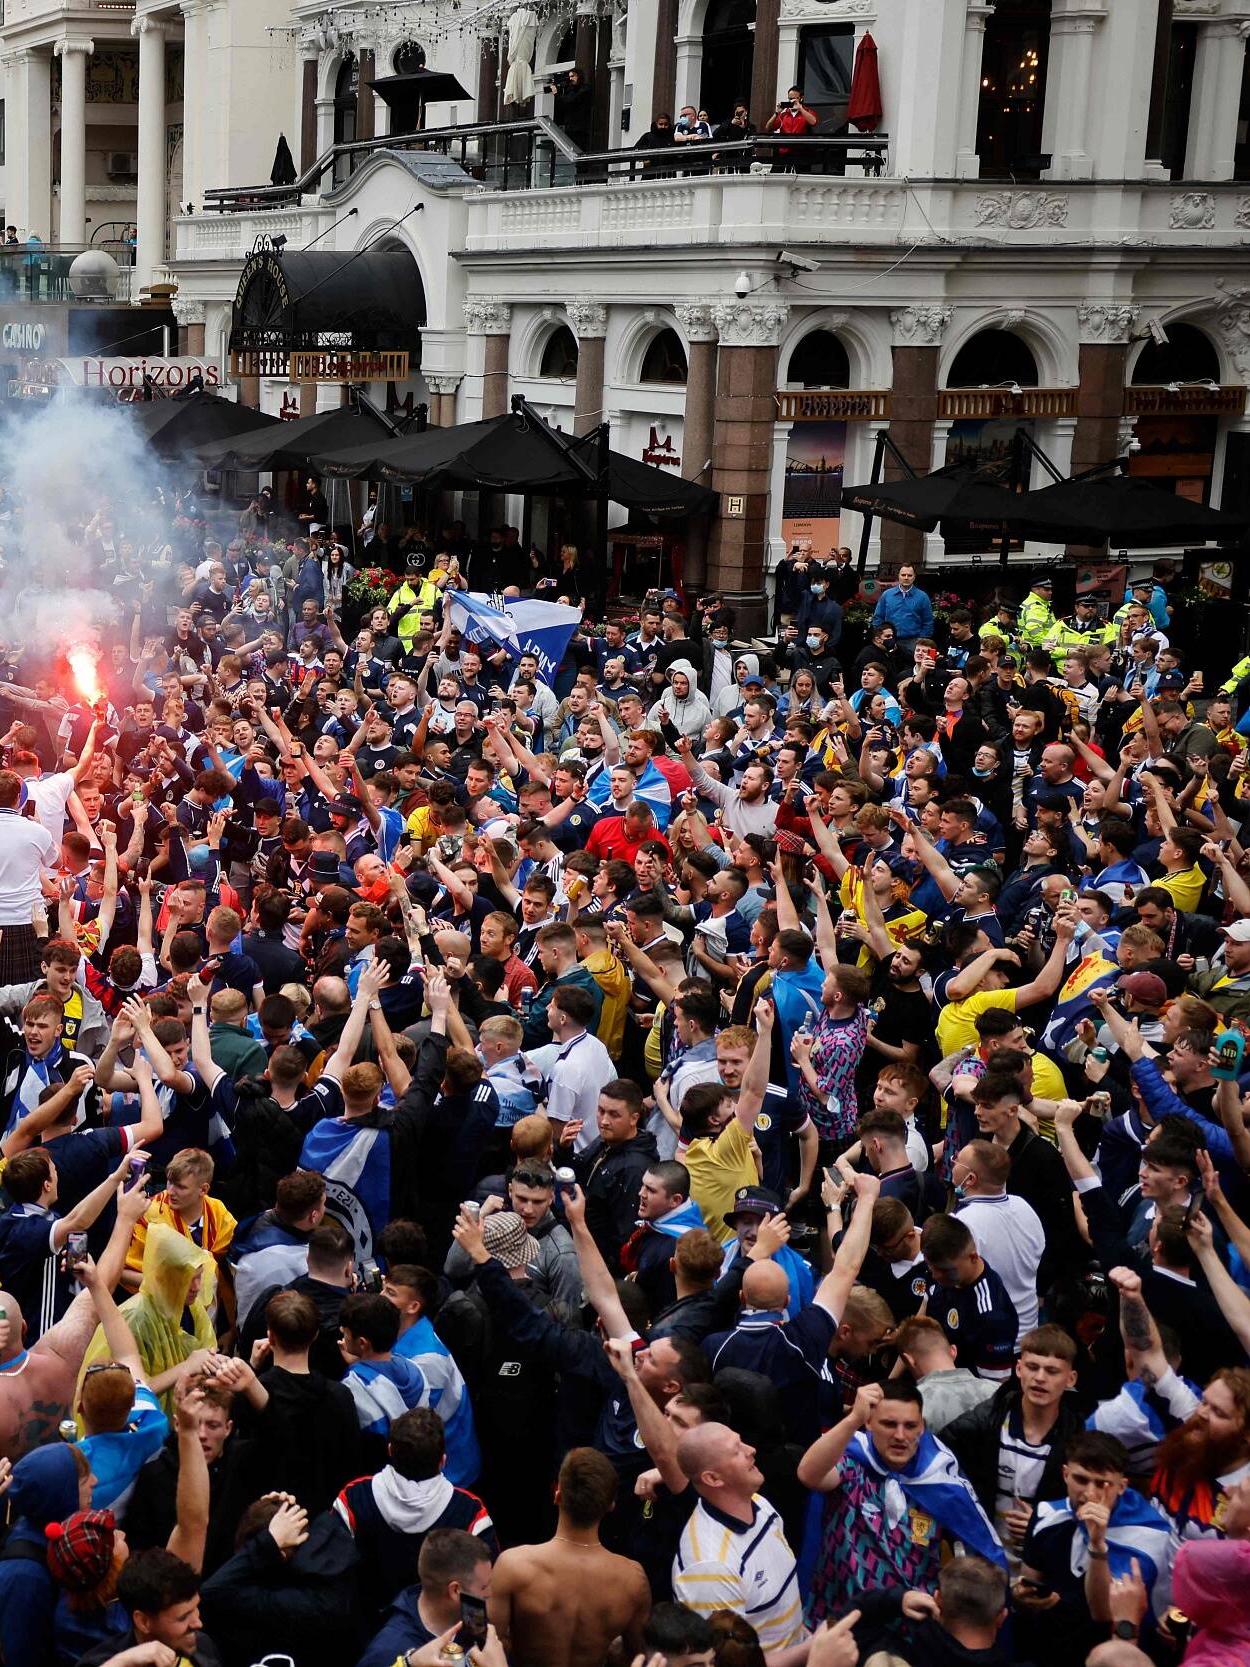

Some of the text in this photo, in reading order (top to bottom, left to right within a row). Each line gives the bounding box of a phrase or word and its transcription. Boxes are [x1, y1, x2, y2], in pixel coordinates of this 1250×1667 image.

[267, 256, 289, 309] HOUSE
[3, 323, 44, 351] CASINO
[83, 359, 219, 387] Horizons
